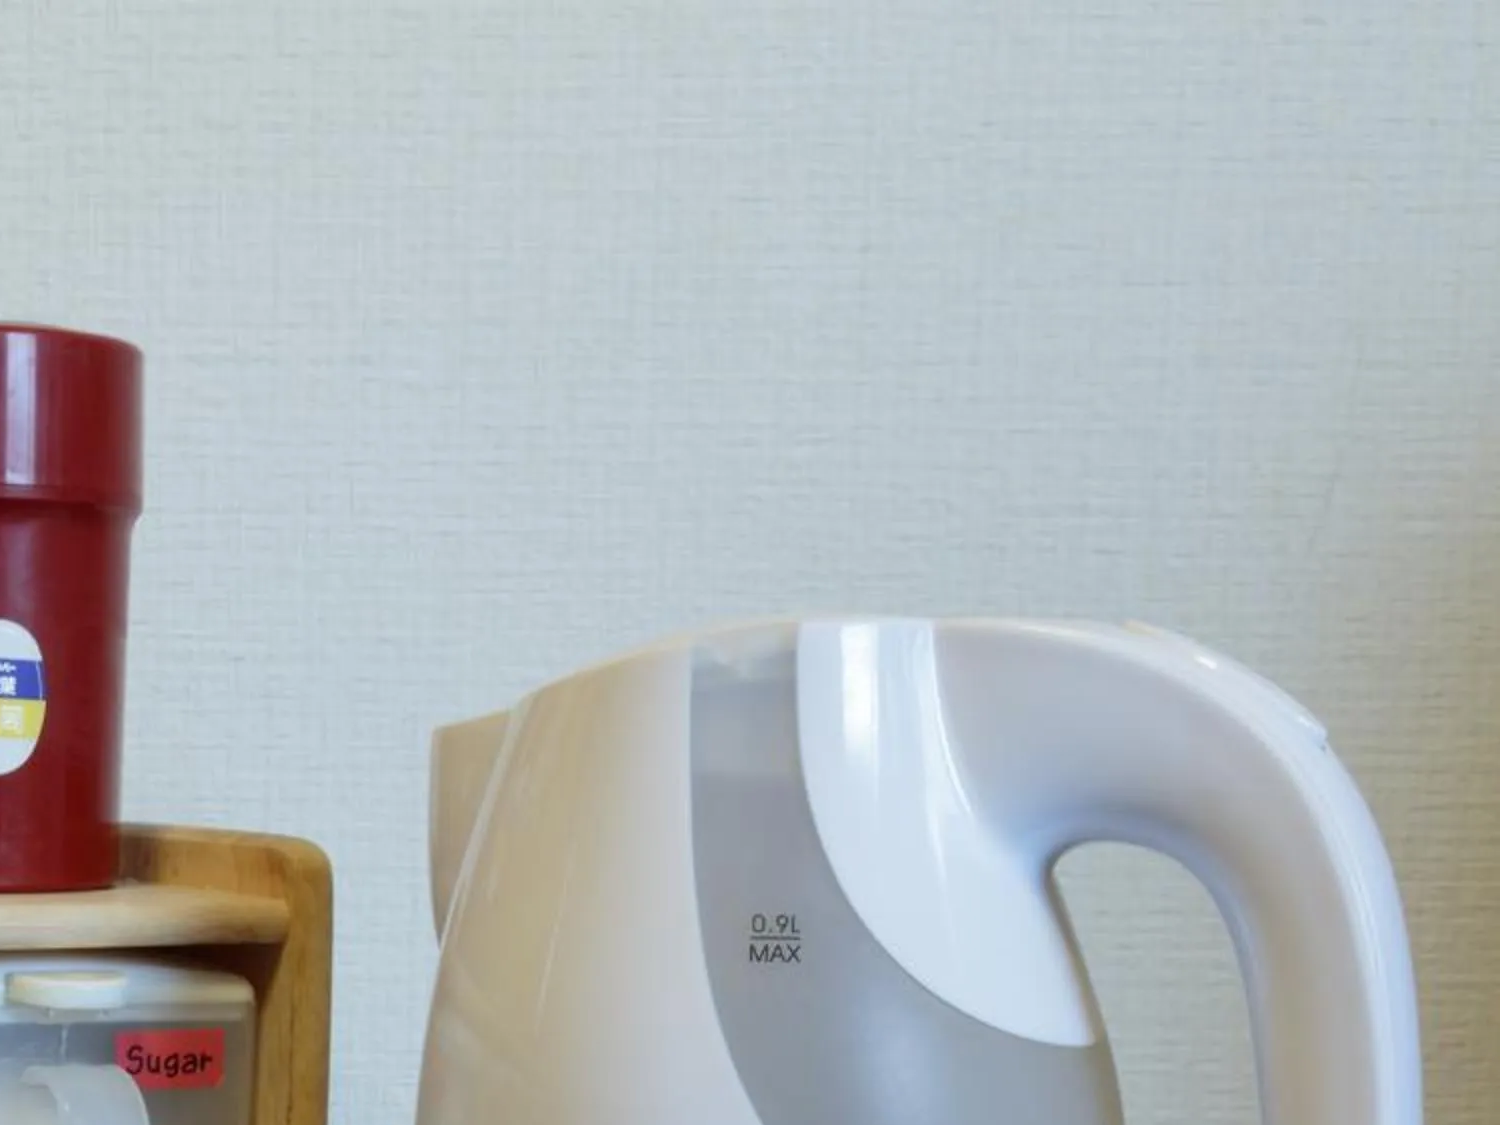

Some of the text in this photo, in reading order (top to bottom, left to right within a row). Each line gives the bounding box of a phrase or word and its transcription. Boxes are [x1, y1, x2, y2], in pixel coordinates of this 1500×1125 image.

[751, 913, 801, 933] 0.9L
[749, 943, 801, 963] MAX
[126, 1044, 213, 1078] Sugar
